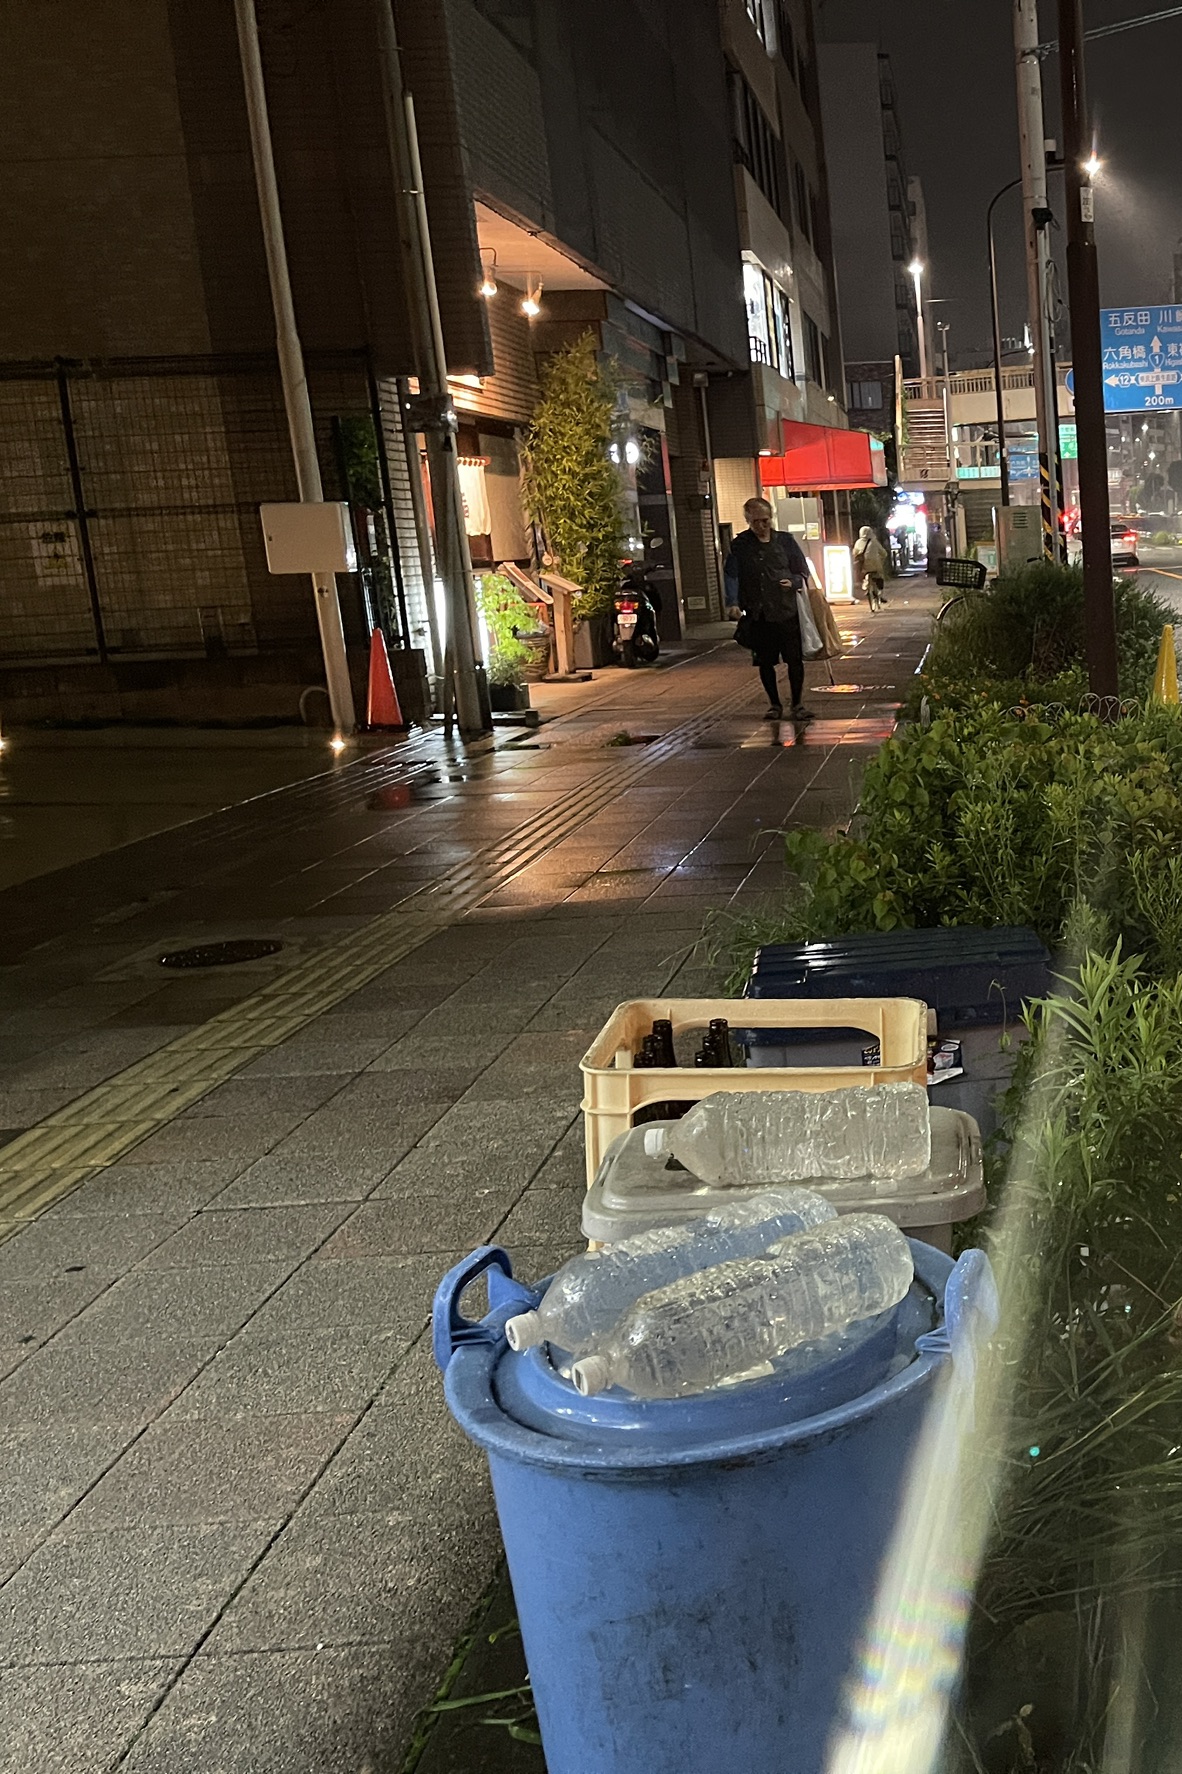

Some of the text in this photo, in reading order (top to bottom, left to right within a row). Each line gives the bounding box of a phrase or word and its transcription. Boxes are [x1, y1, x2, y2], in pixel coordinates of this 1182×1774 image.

[1108, 311, 1150, 327] 五反田
[1114, 327, 1145, 336] Gotanda
[1103, 345, 1146, 361] 六角橋
[1119, 375, 1130, 385] 12
[1144, 396, 1174, 406] 200m
